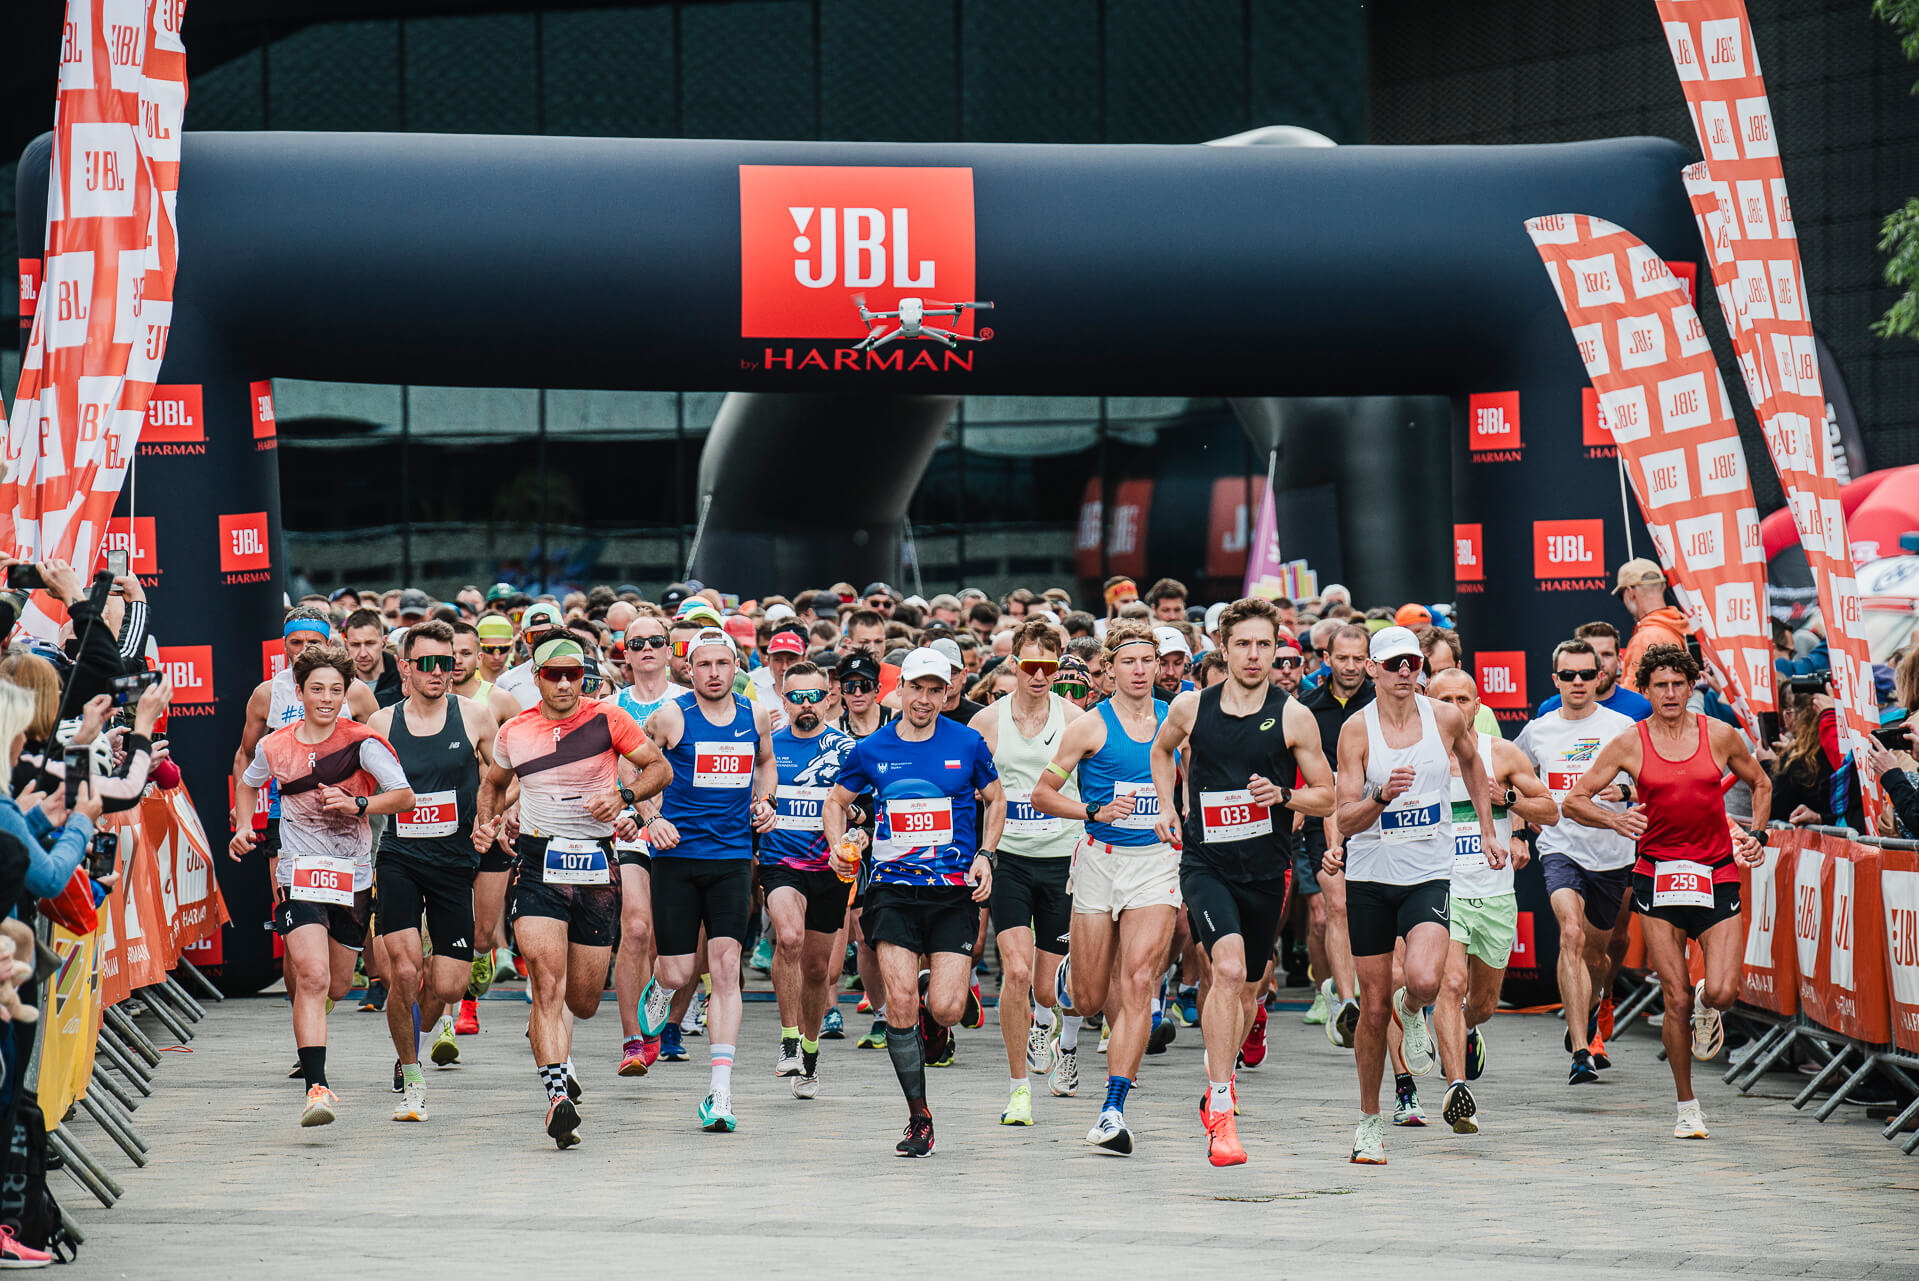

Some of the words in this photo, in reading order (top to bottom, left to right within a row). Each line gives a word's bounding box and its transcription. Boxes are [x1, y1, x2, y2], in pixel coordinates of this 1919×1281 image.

[63, 22, 83, 64] BL
[85, 151, 125, 192] JBL
[788, 207, 936, 288] JBL
[58, 279, 87, 322] BL
[741, 359, 759, 371] by
[764, 348, 974, 372] HARMAN
[148, 400, 192, 427] JBL
[1477, 408, 1511, 435] JBL
[142, 444, 206, 456] HARMAN
[1472, 451, 1522, 463] HARMAN
[231, 529, 264, 556] JBL
[1457, 539, 1477, 566] JBL
[1547, 534, 1593, 563] JBL
[227, 572, 271, 586] HARMAN
[1541, 579, 1606, 592] HARMAN
[1483, 666, 1517, 694] JBL
[167, 704, 216, 717] ARMAN
[711, 756, 739, 773] 308
[255, 786, 271, 814] BL
[788, 799, 818, 816] 1170
[1132, 797, 1160, 814] 010
[413, 806, 440, 824] 202
[904, 813, 934, 831] 399
[1220, 805, 1250, 825] 033
[1395, 807, 1431, 827] 1274
[560, 853, 593, 870] 1077
[310, 870, 338, 889] 066
[1670, 874, 1698, 890] 259
